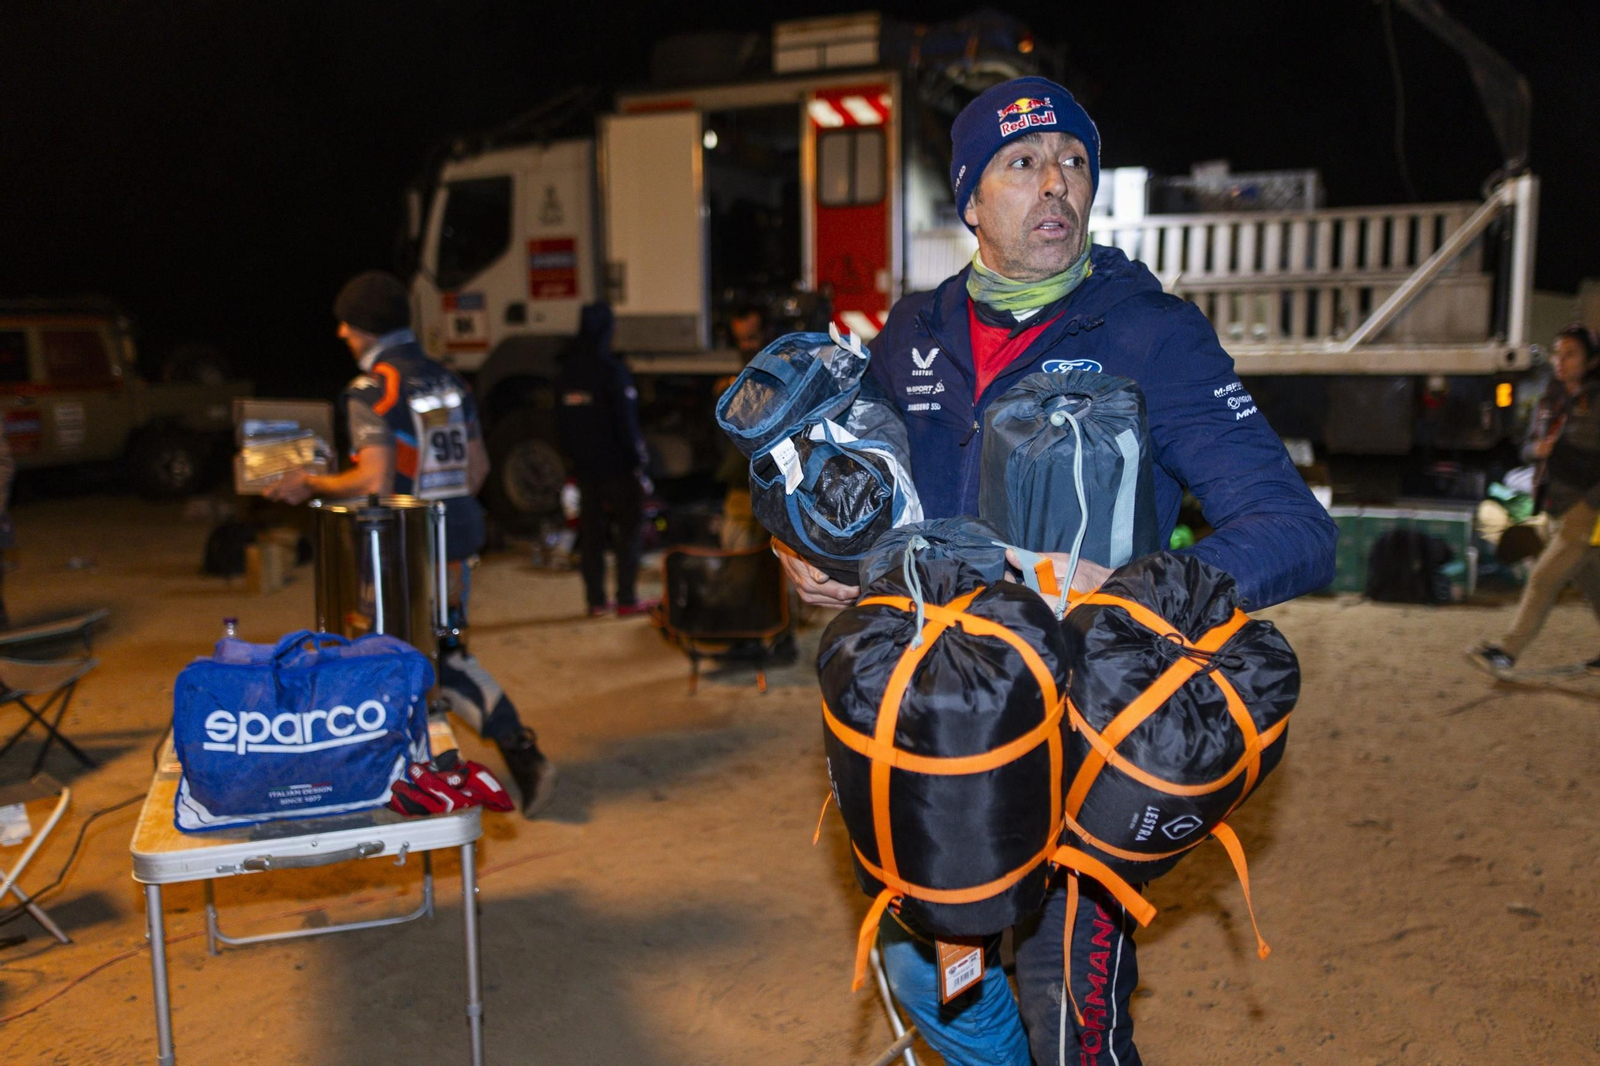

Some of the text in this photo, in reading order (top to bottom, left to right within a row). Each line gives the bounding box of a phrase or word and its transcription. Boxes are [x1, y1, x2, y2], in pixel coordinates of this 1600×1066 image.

[1001, 111, 1056, 136] Red Bull
[204, 700, 387, 756] sparco
[268, 785, 333, 799] ITALIAN DESIGN
[1135, 805, 1161, 841] LESTRA
